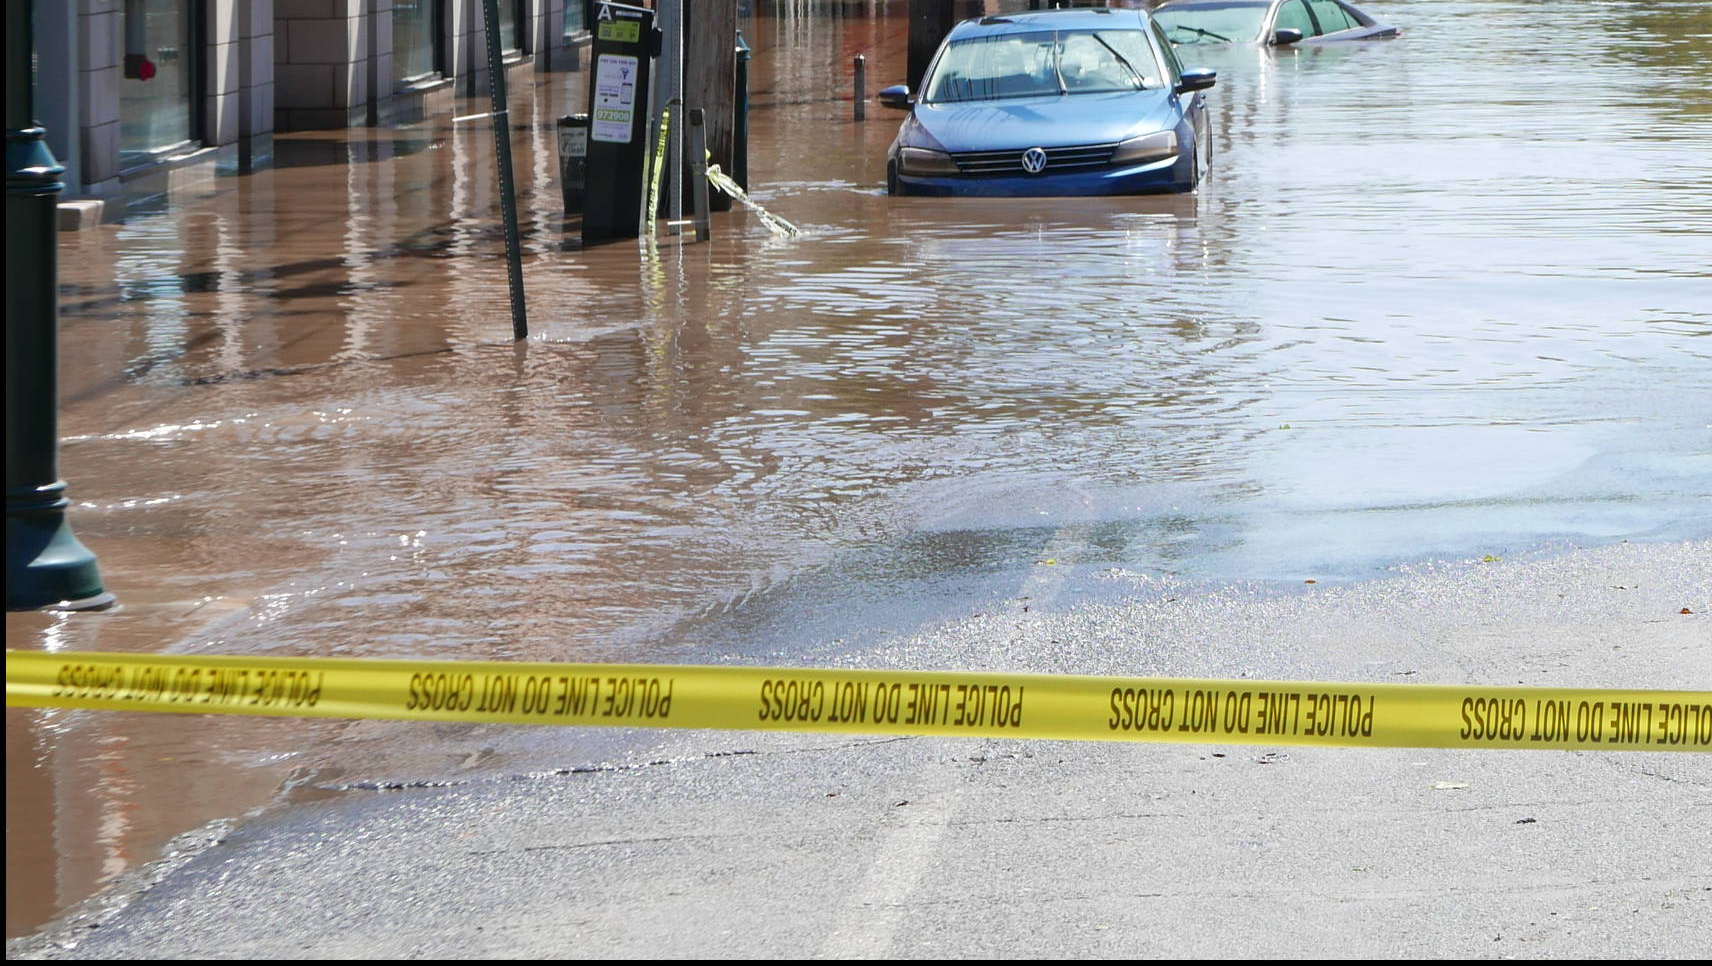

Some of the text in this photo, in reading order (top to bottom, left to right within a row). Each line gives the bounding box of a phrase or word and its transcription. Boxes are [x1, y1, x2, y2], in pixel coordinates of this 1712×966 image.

[597, 3, 613, 21] A
[407, 673, 673, 718] POLICE LINE DO NOT CROSS
[759, 680, 1023, 727] POLICE LINE DO NOT CROSS
[1109, 688, 1374, 737] POLICE LINE DO NOT CROSS
[1461, 697, 1525, 741] CROSS
[1531, 700, 1571, 741] NOT
[1577, 701, 1604, 742] DO
[1609, 703, 1652, 744] LINE
